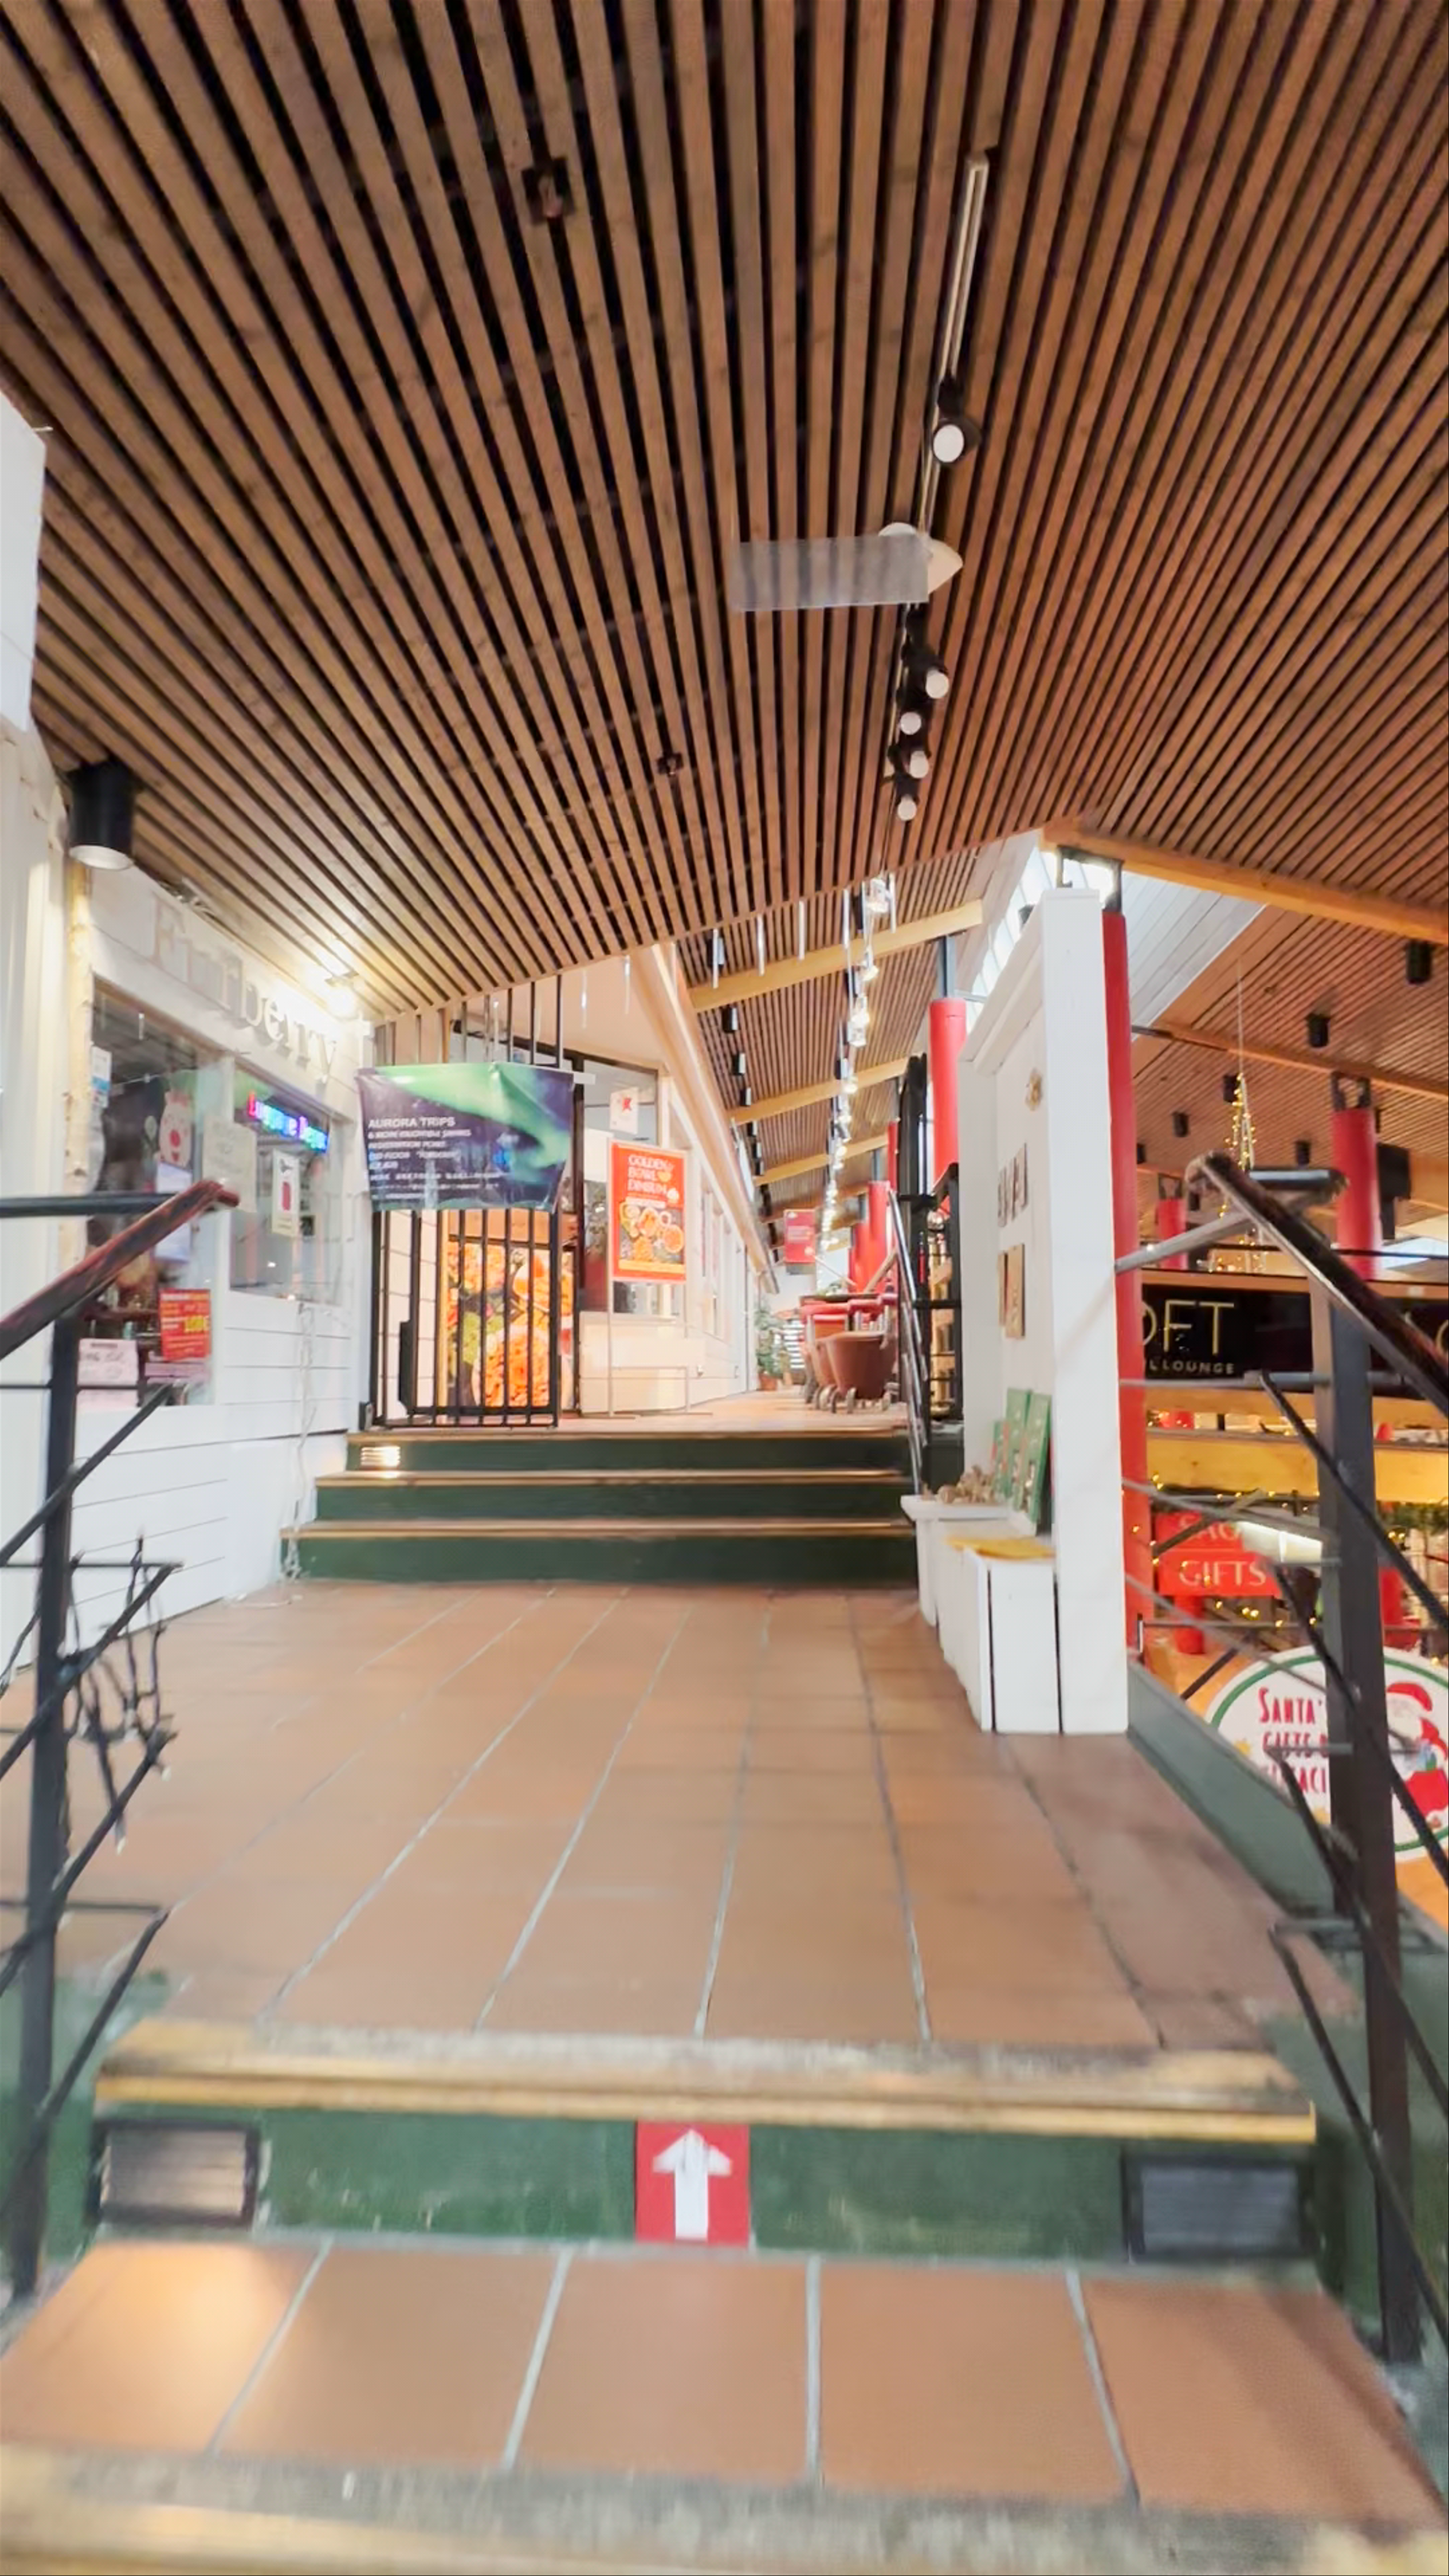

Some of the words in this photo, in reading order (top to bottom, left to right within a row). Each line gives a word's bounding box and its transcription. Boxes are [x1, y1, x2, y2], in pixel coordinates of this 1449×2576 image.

[368, 1118, 417, 1129] AURORA
[418, 1117, 455, 1127] TRIPS
[629, 1154, 666, 1170] GOLDEN
[1143, 1300, 1234, 1355] FT
[1163, 1359, 1235, 1375] LOUNGE
[1179, 1560, 1266, 1586] GIFTS
